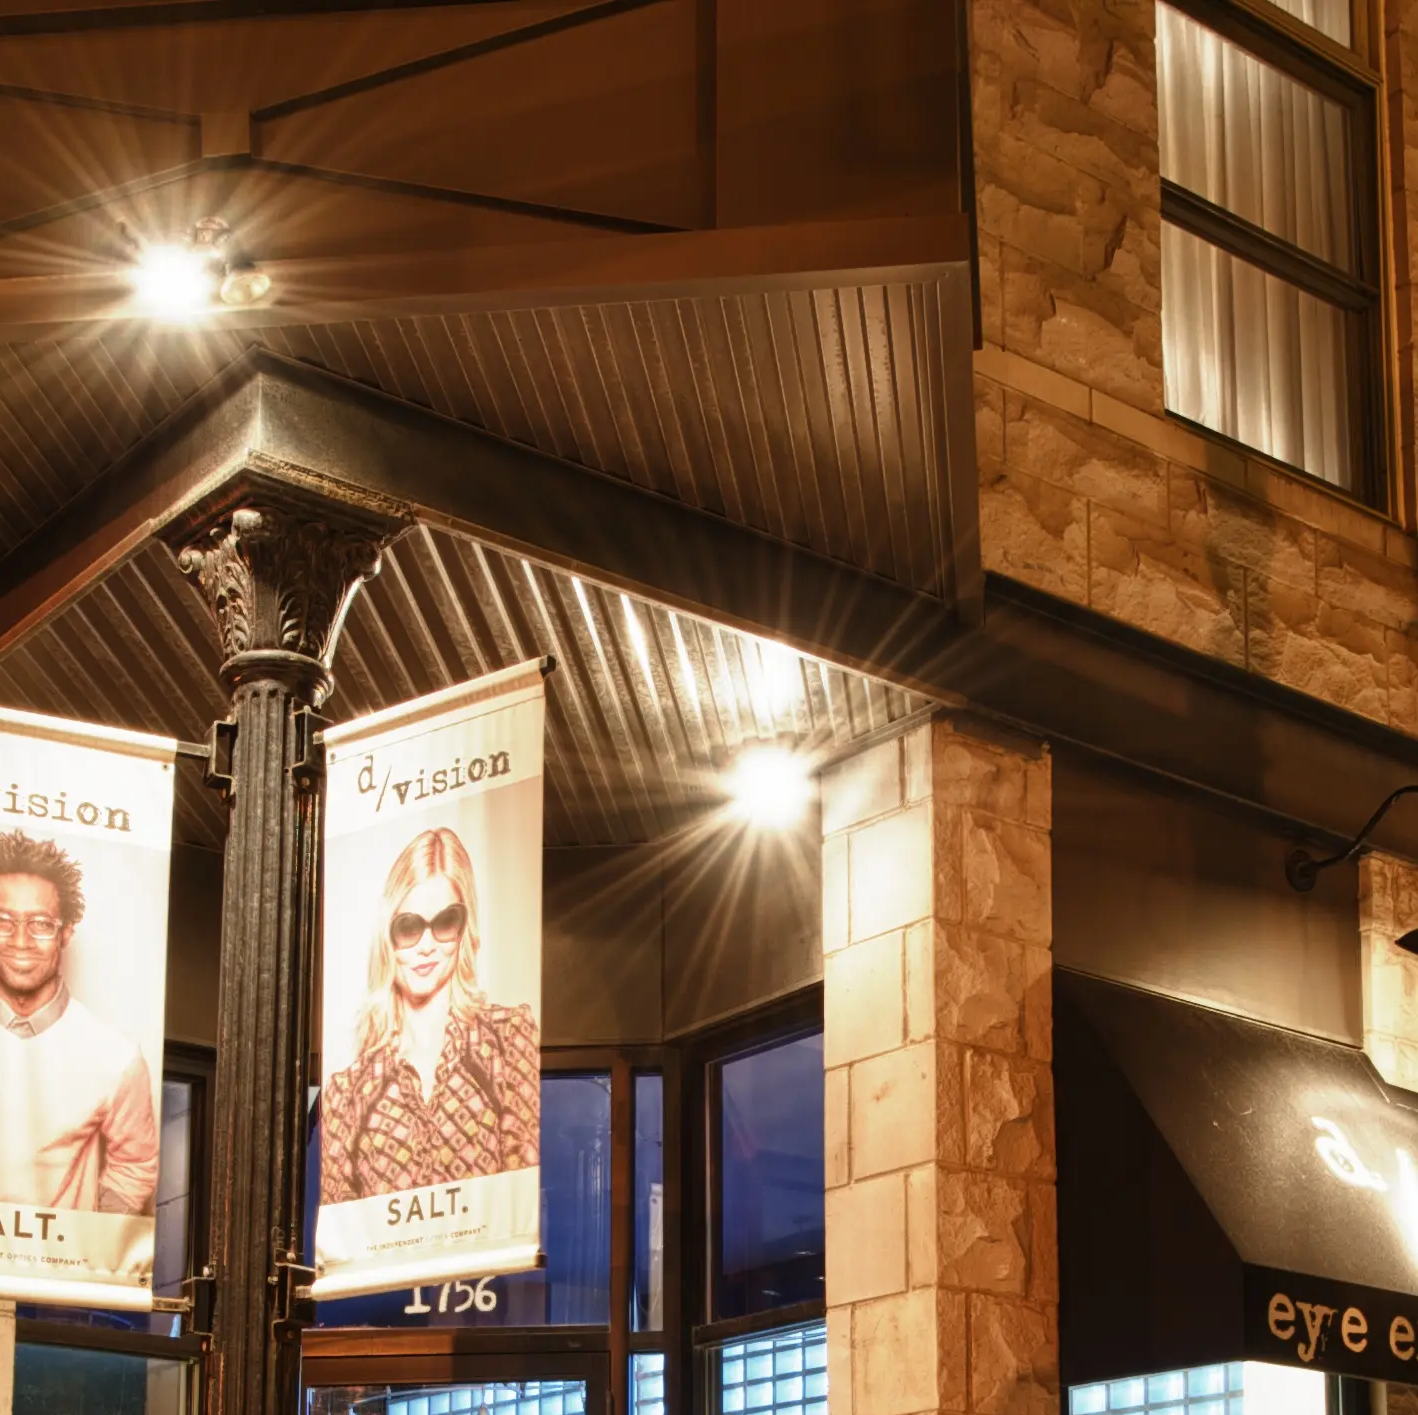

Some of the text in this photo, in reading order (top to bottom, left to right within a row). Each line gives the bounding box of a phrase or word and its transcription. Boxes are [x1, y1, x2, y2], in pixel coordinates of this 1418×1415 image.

[357, 749, 512, 812] d/vision
[386, 1186, 469, 1226] SALT.
[1267, 1292, 1369, 1363] eye
